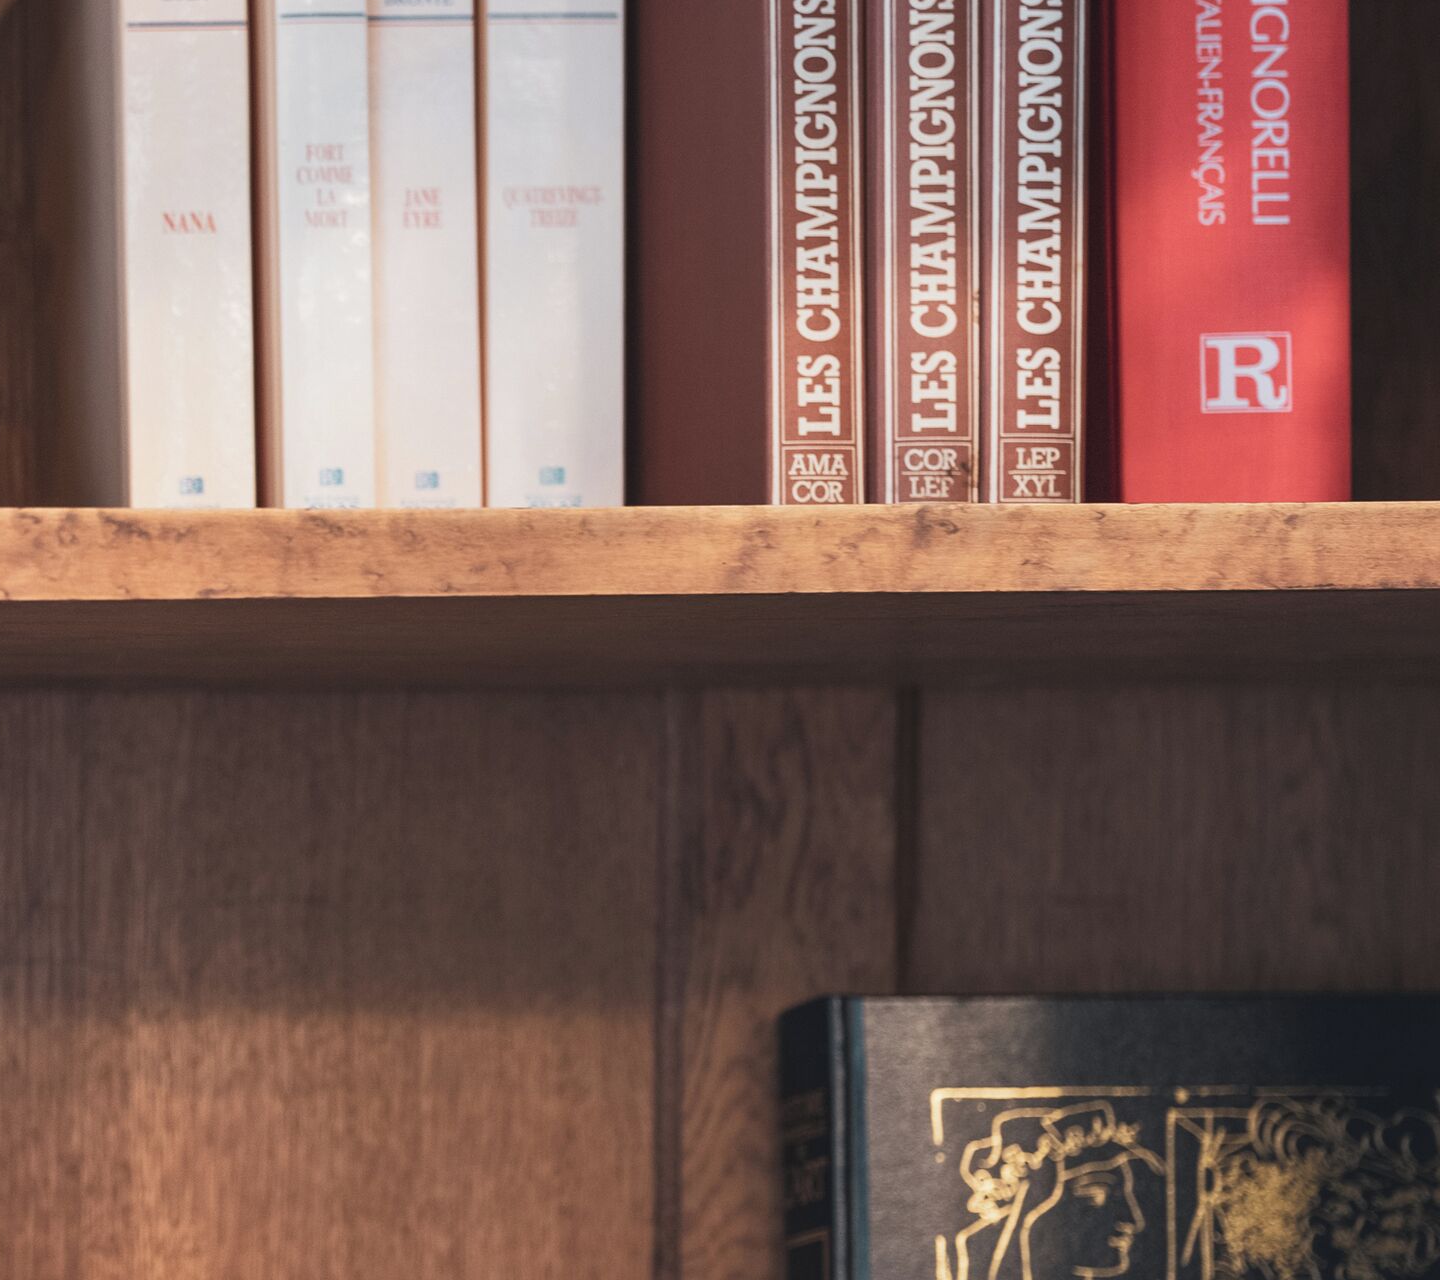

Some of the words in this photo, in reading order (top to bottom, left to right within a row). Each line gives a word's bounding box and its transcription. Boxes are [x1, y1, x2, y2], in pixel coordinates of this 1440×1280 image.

[404, 187, 441, 207] JANE
[162, 212, 217, 234] NANA
[403, 211, 443, 228] EYRE
[1206, 338, 1287, 410] R
[796, 354, 841, 436] LES
[911, 350, 957, 432] LES
[1016, 346, 1061, 430] LES
[788, 454, 848, 476] AMA
[903, 448, 958, 471] COR
[1016, 447, 1061, 469] LEP
[791, 481, 844, 504] COR
[1013, 475, 1061, 497] XYL
